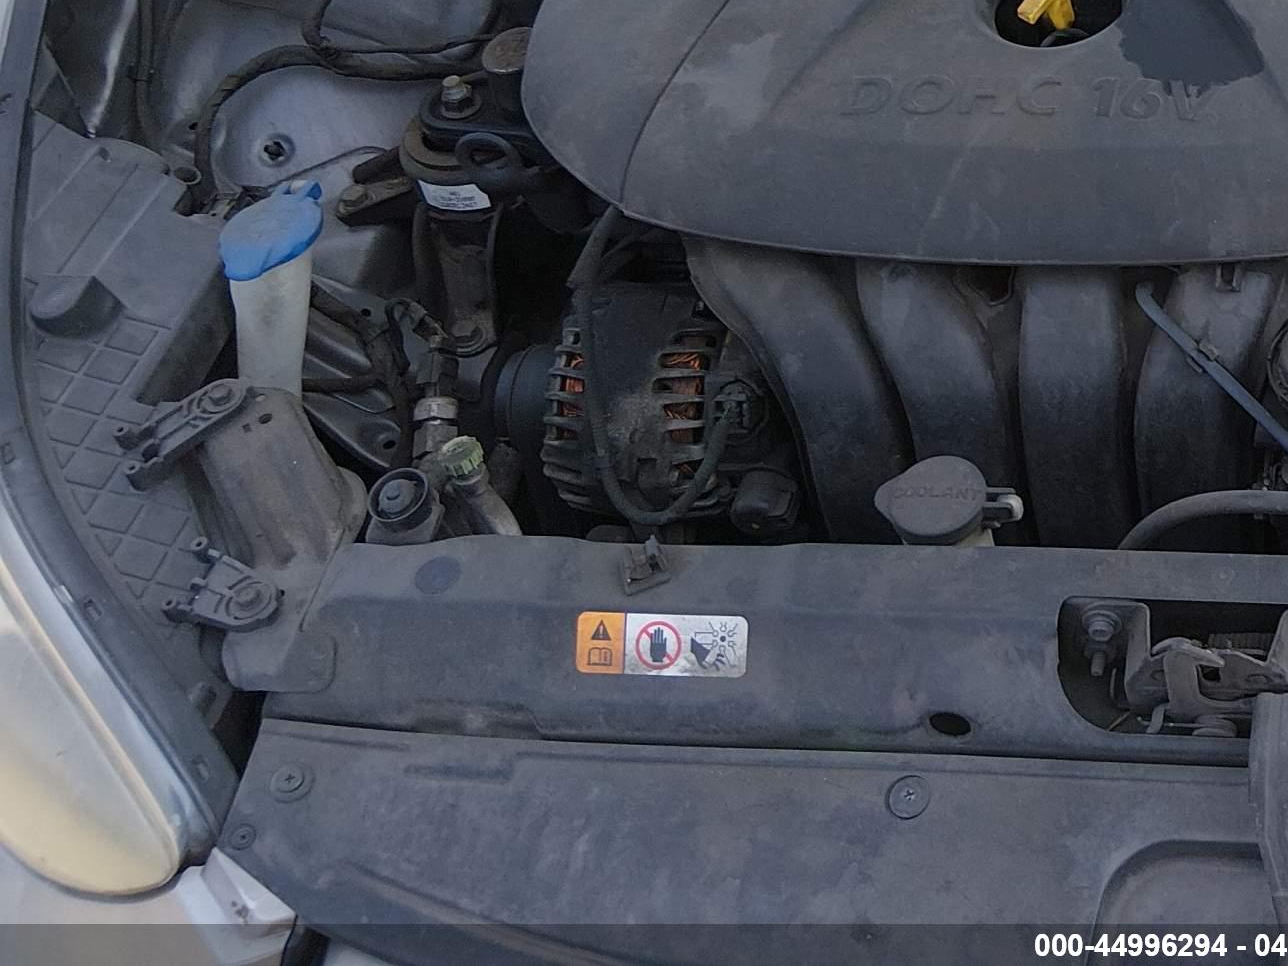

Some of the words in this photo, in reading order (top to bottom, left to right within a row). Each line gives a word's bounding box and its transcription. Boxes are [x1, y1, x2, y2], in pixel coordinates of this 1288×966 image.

[840, 74, 1063, 116] DOHC
[1088, 76, 1212, 121] 16V
[894, 486, 982, 500] COOLANT
